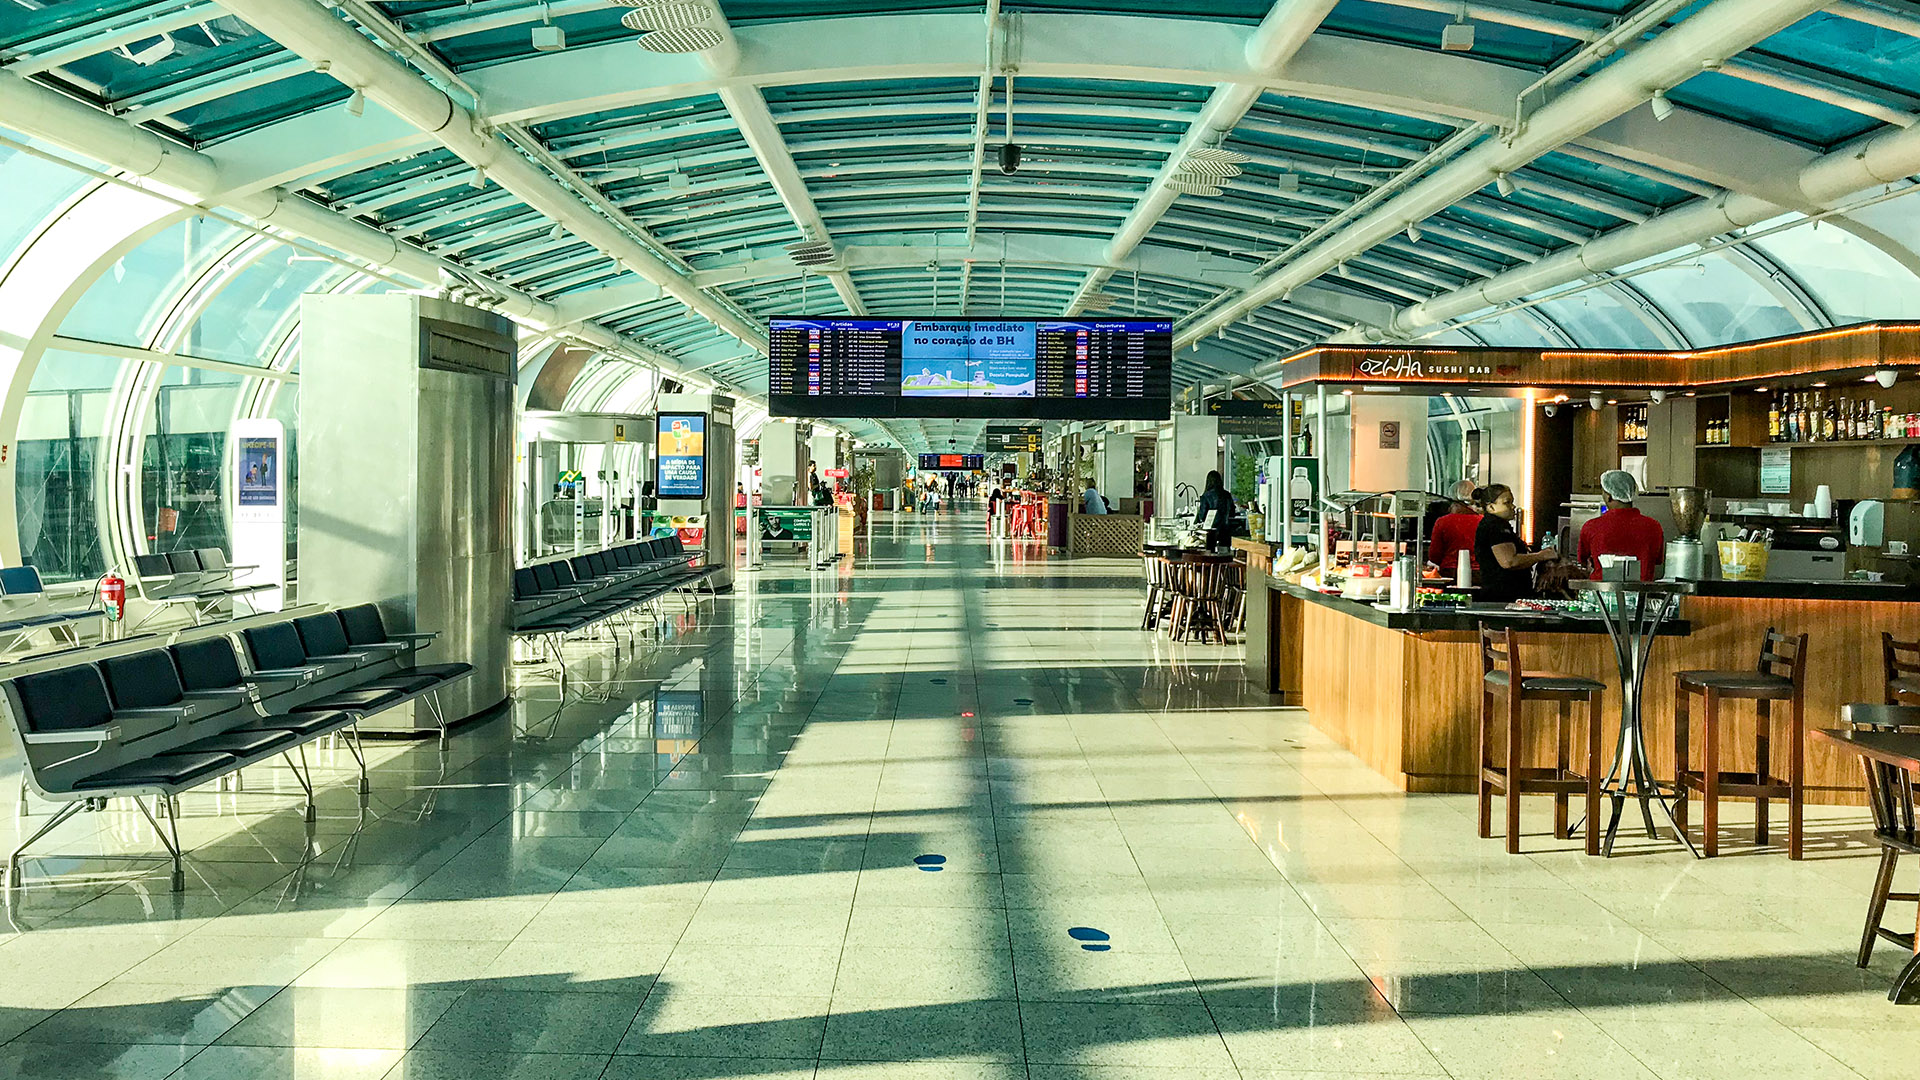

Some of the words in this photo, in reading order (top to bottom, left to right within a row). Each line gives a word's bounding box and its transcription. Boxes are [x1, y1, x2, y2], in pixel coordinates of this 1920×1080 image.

[914, 323, 971, 333] Embarque
[974, 323, 1024, 332] imediato
[932, 336, 976, 346] coração
[980, 336, 993, 345] de
[997, 337, 1014, 345] BH
[1428, 365, 1463, 374] SUSHI
[1469, 366, 1490, 374] BAR
